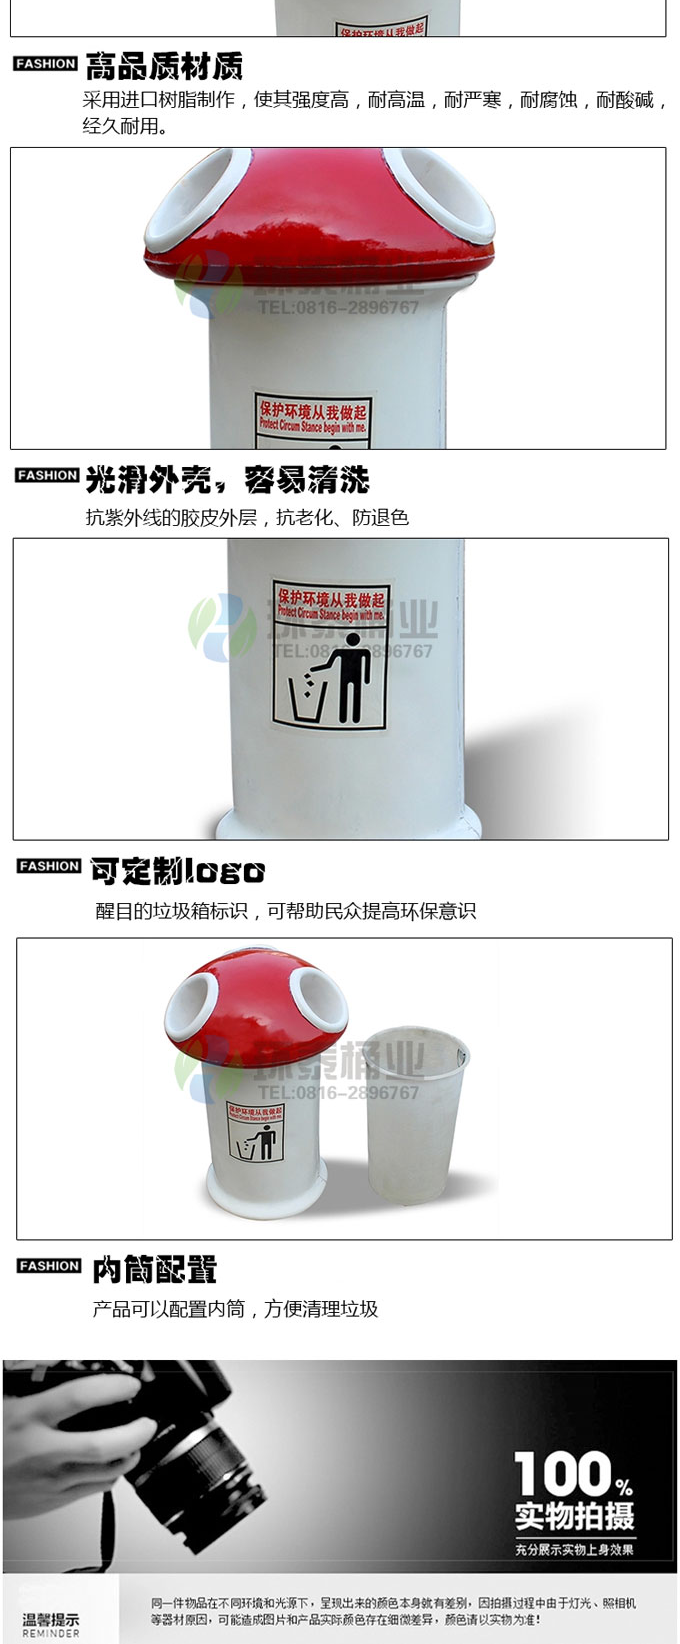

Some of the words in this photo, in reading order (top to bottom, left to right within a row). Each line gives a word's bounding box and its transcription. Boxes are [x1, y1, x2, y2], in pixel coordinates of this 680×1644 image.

[260, 400, 367, 421] 保护环境从我做起
[260, 416, 278, 430] Protect
[280, 418, 300, 432] Circum
[301, 420, 322, 433] Stance
[323, 421, 340, 436] begin
[341, 421, 354, 433] with
[277, 588, 385, 609] 保护环境从我做起
[277, 604, 297, 618] Protect
[297, 606, 319, 620] Circum
[319, 608, 341, 621] Stance
[341, 608, 359, 624] begin
[359, 608, 373, 621] with
